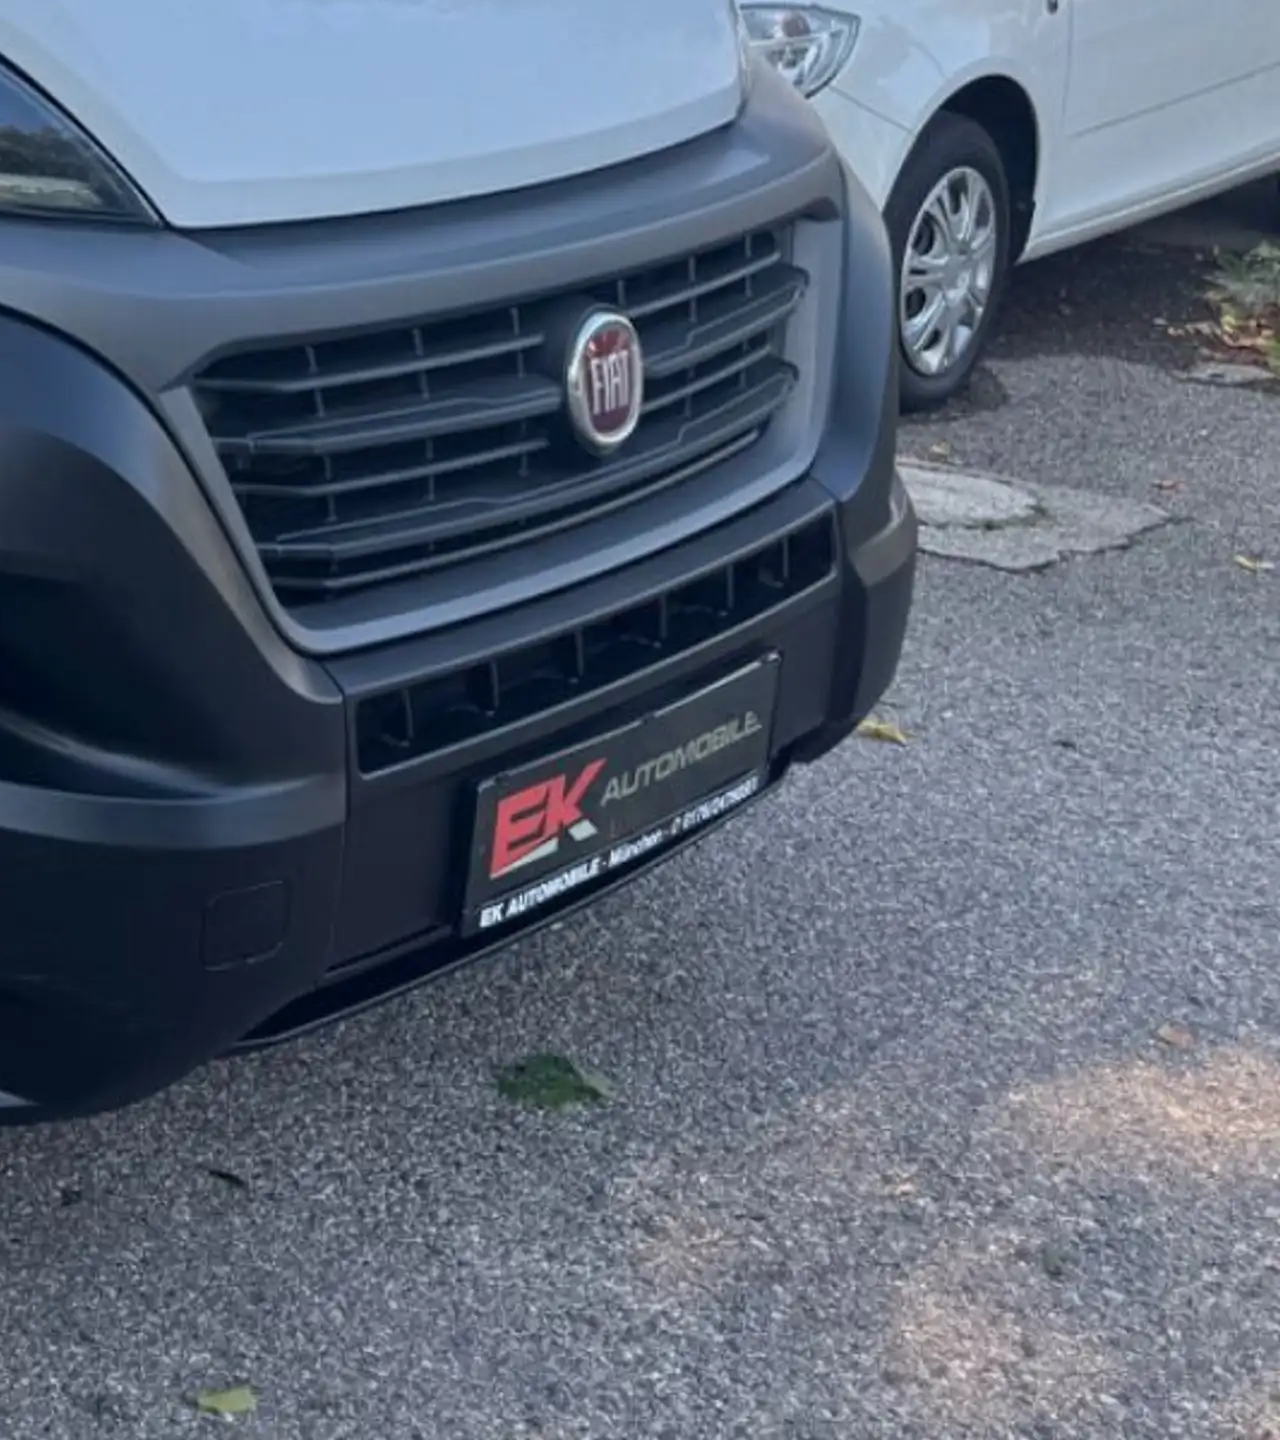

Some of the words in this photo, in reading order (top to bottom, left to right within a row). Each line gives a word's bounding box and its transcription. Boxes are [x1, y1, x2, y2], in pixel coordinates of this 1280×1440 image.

[591, 349, 629, 415] FIAT
[490, 757, 608, 878] EK
[599, 710, 762, 807] AUTOMOBILE
[479, 902, 505, 928] EK
